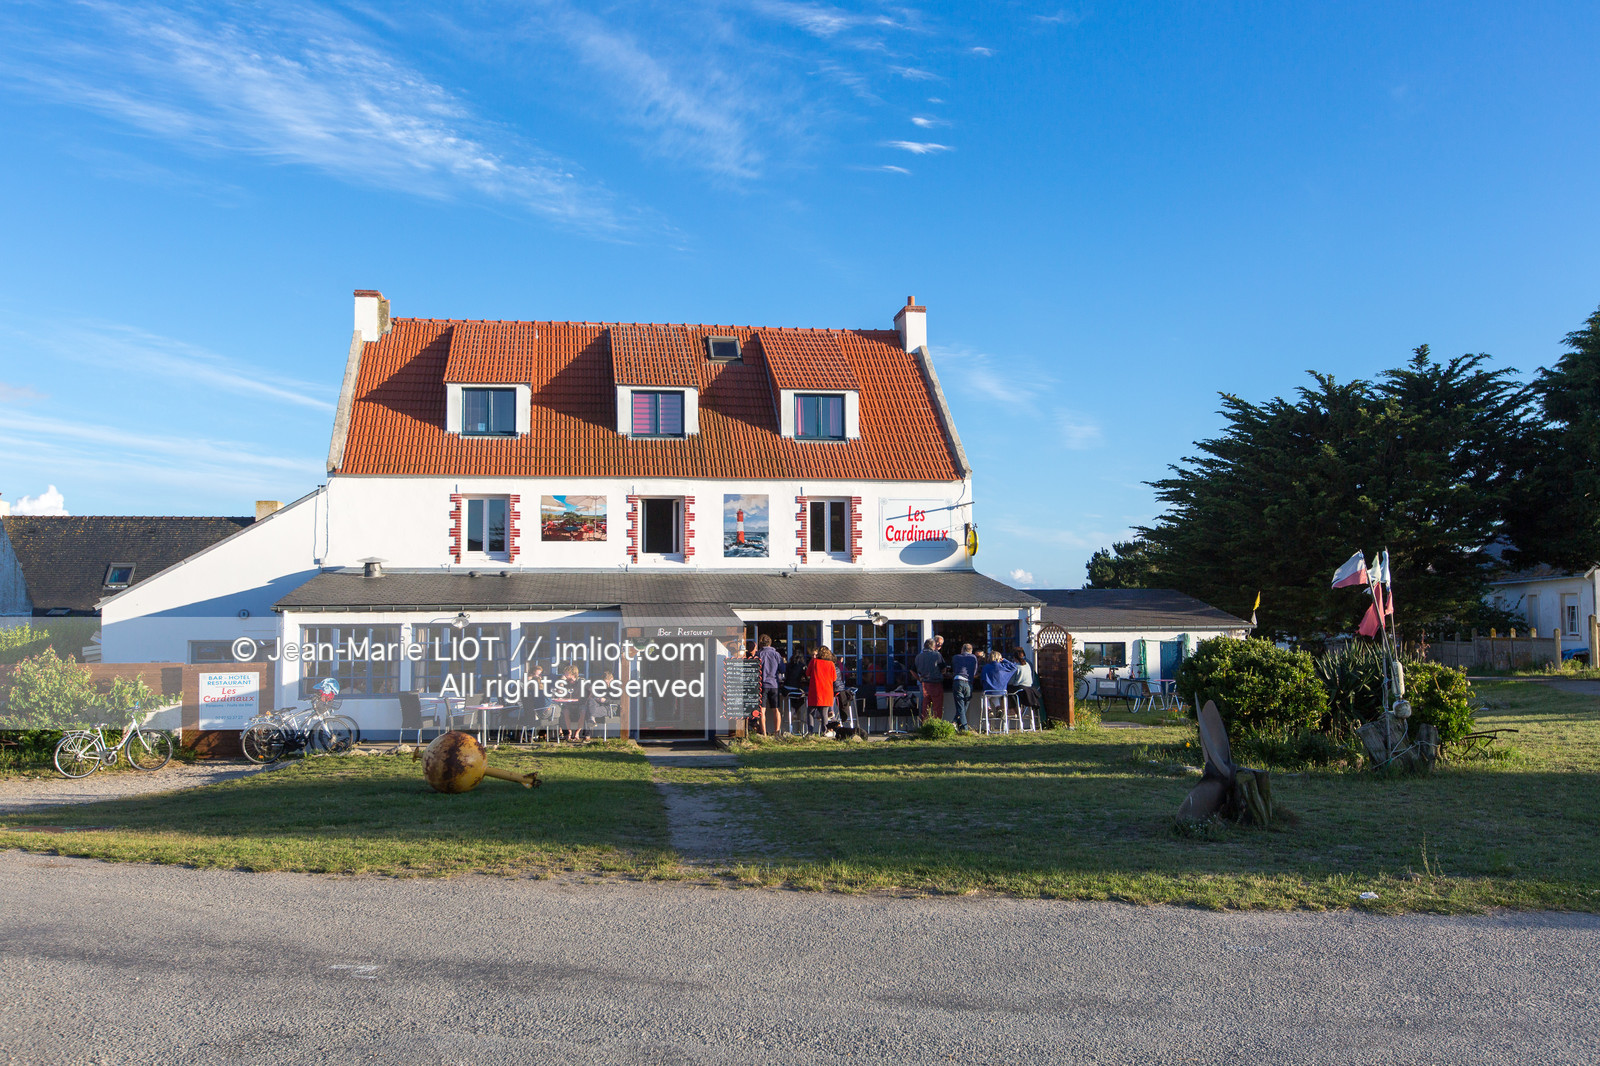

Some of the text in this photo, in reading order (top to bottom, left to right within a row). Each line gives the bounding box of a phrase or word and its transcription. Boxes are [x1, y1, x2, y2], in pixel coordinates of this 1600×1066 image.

[908, 506, 926, 522] Les
[886, 524, 948, 542] Cardinaux
[657, 628, 713, 636] Bar Restaurant
